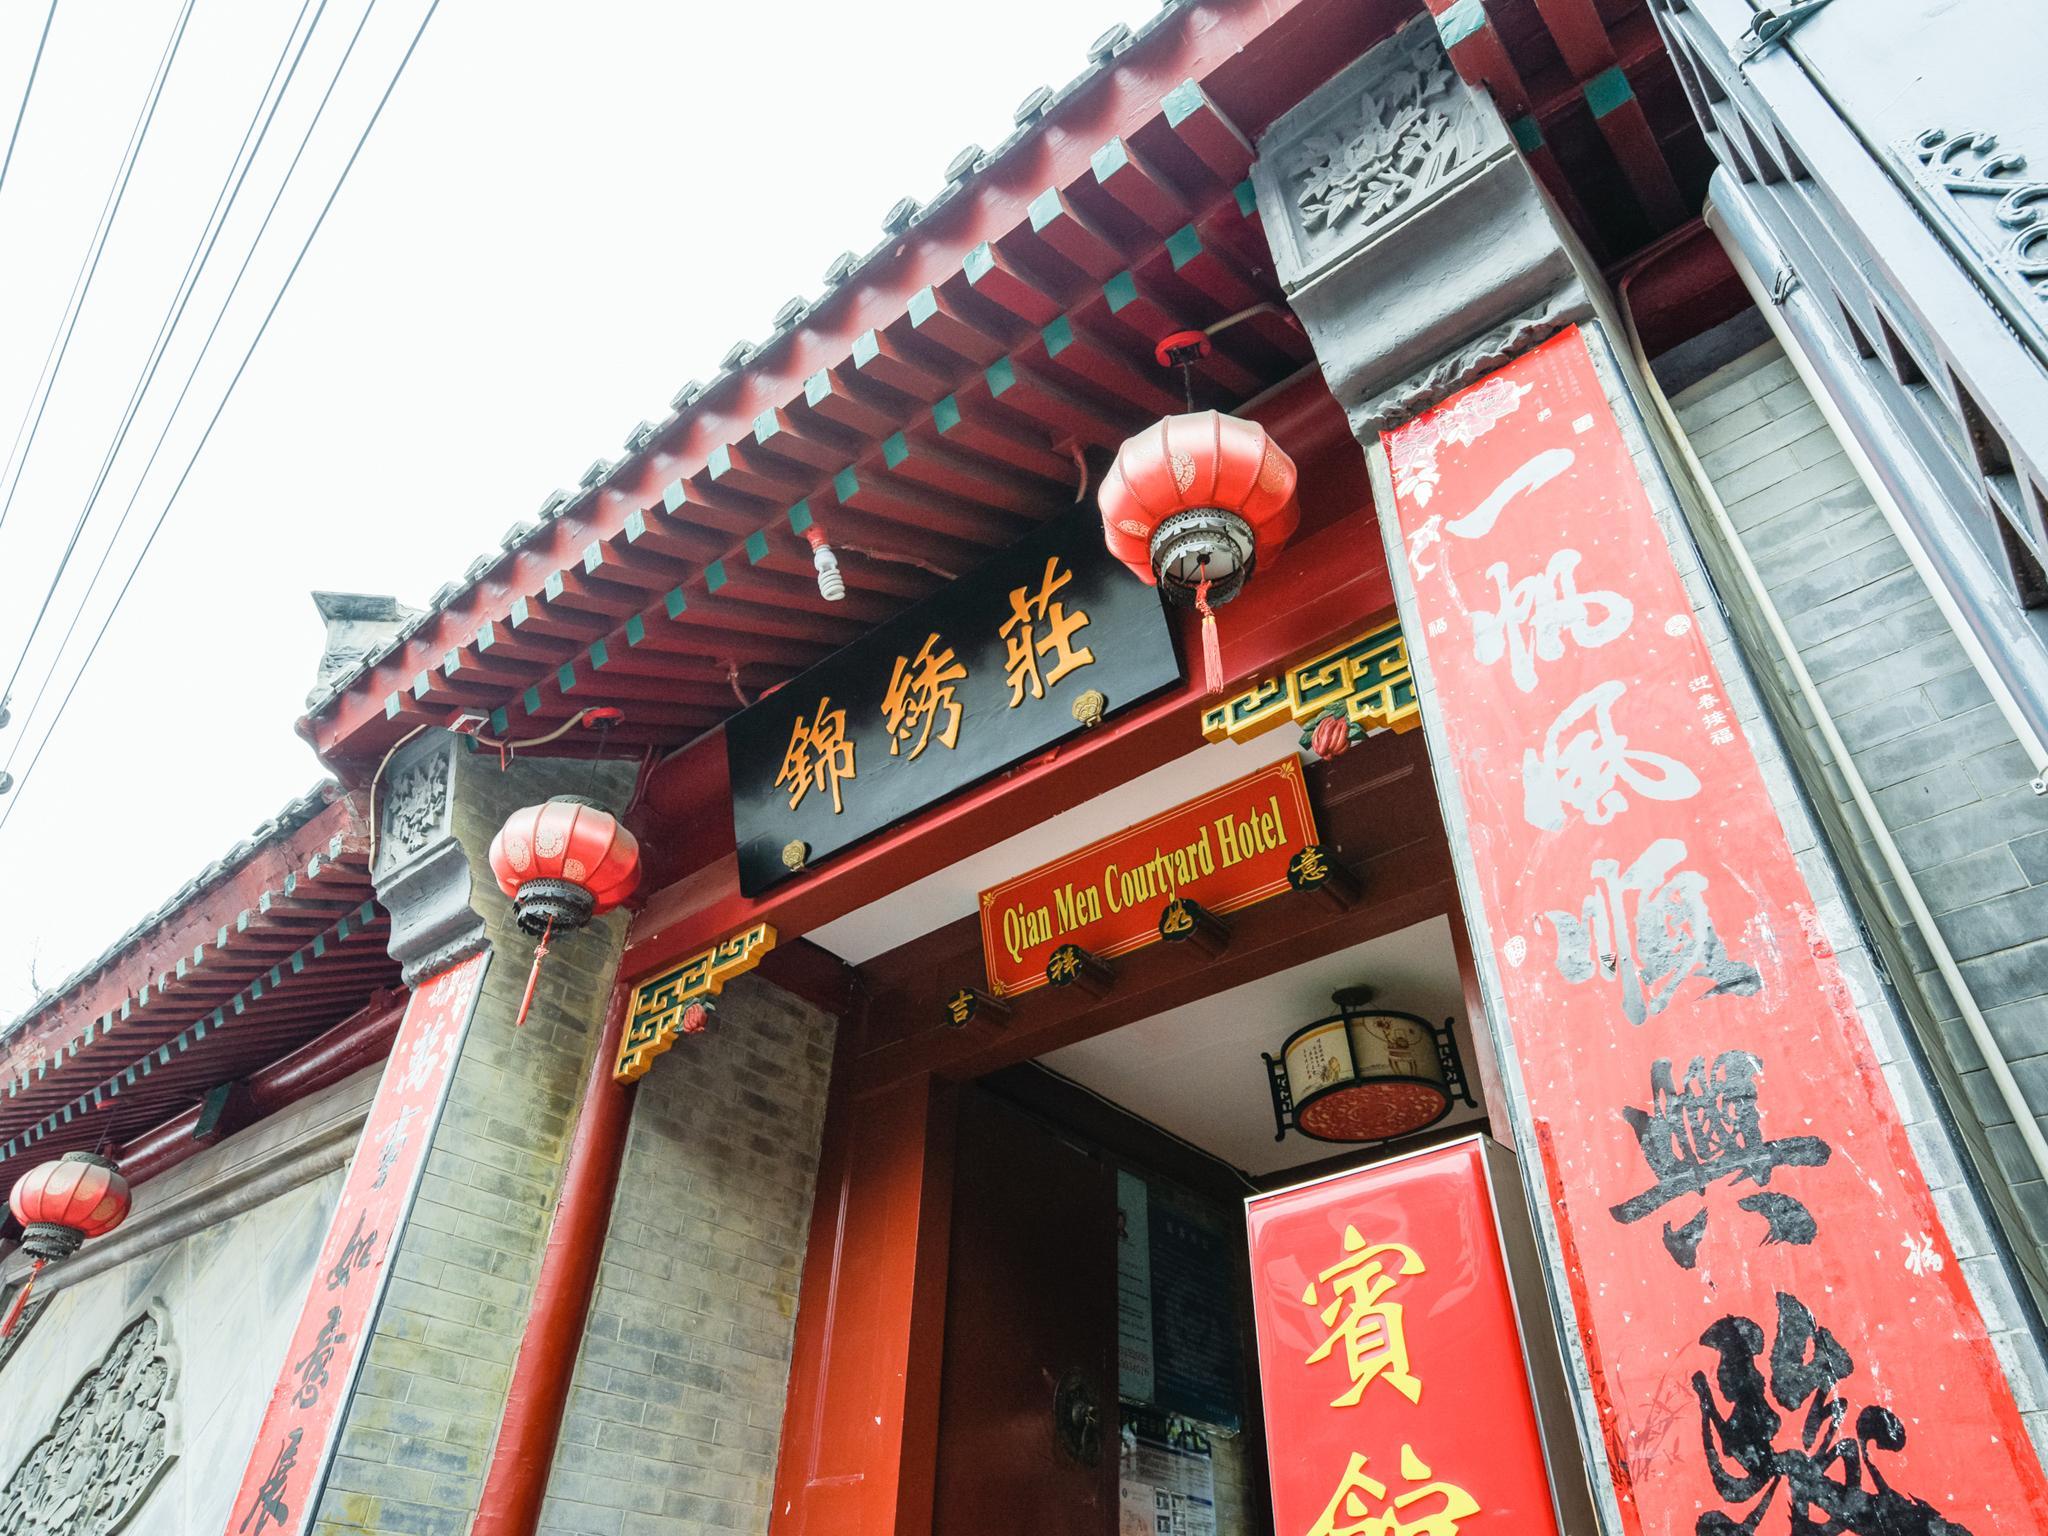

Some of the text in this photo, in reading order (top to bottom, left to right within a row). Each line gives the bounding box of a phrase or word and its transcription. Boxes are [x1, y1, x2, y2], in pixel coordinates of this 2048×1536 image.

[1687, 674, 1735, 746] 迎春接福
[1003, 795, 1287, 964] Qian Men Courtyard Hotel
